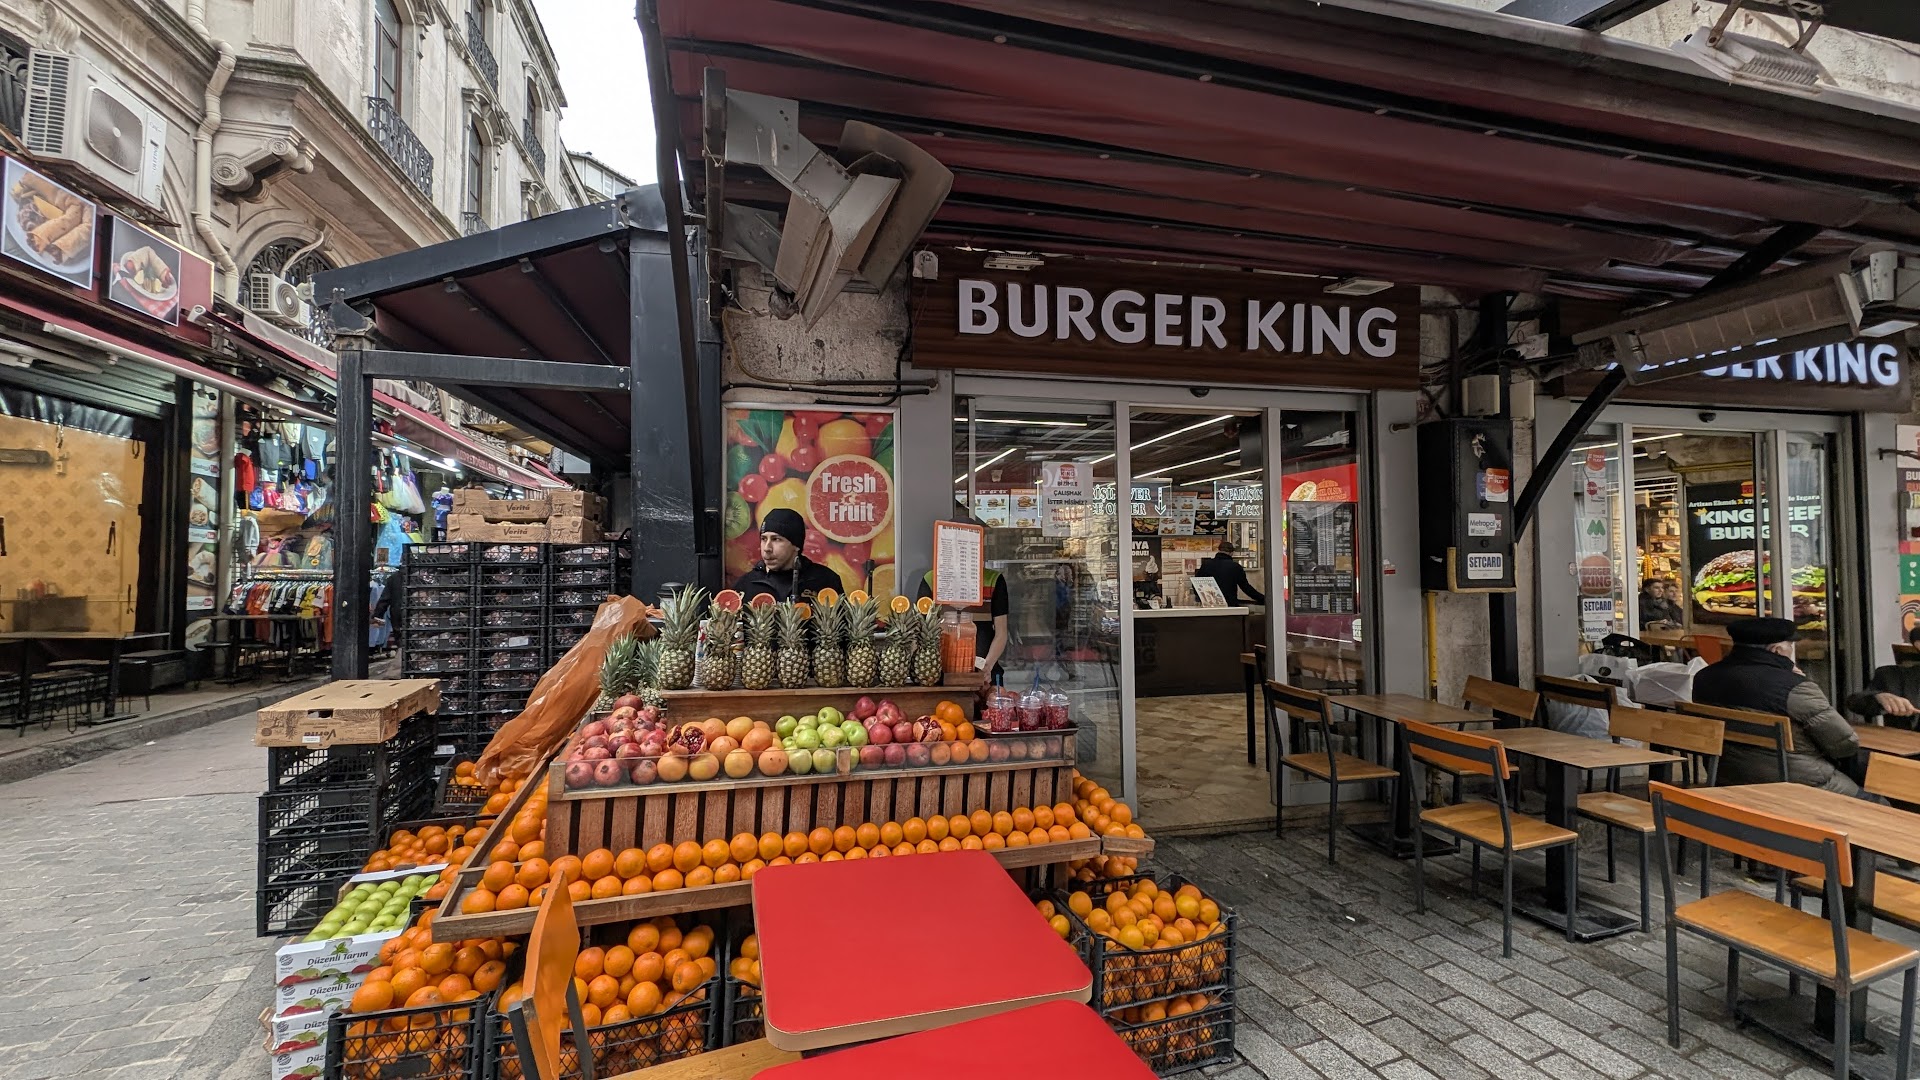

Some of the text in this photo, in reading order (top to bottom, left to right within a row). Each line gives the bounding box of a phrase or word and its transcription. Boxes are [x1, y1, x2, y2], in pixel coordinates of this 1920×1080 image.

[958, 278, 1398, 358] BURGER KING
[1794, 340, 1899, 386] KING
[822, 472, 876, 493] Fresh
[1053, 489, 1082, 497] ÇALIŞMAK
[829, 501, 874, 522] Fruit
[1699, 508, 1756, 525] KING
[1469, 520, 1496, 528] Metropol
[1709, 524, 1810, 541] BURGR
[1469, 556, 1501, 568] SETCARD
[1580, 567, 1611, 576] BURGER
[1582, 576, 1612, 588] KING
[1583, 600, 1612, 611] SETCARD
[1585, 626, 1607, 634] Metropol
[307, 955, 341, 966] Düzenli
[342, 951, 368, 961] Tarım
[309, 984, 343, 996] Düzenli
[344, 981, 362, 990] Tarı
[304, 1020, 328, 1030] Düze
